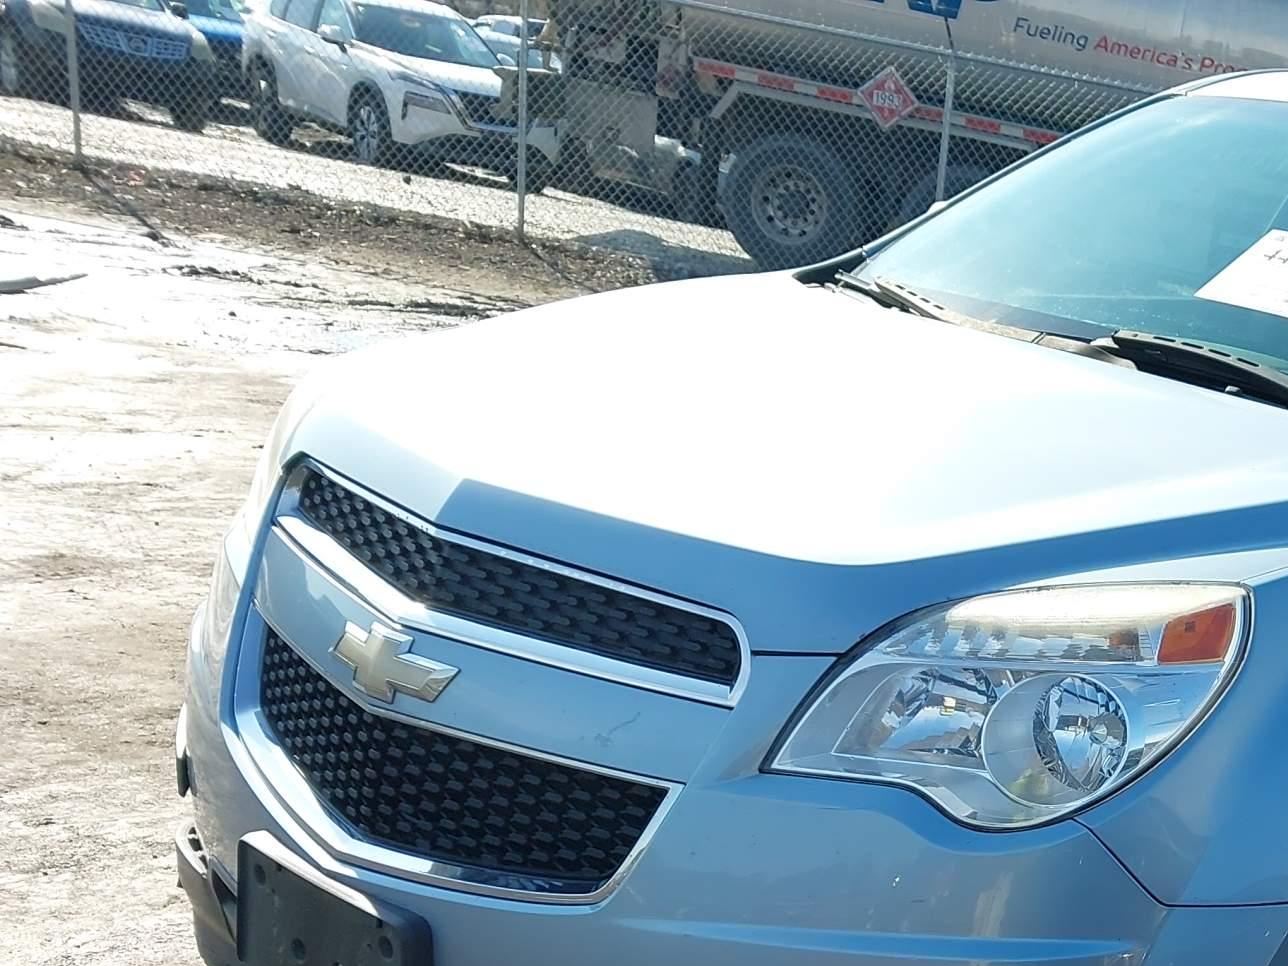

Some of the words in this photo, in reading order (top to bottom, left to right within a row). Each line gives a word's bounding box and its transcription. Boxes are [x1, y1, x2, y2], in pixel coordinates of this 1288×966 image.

[1012, 16, 1090, 52] Fueling
[1093, 35, 1194, 71] America's
[875, 91, 902, 109] 1993
